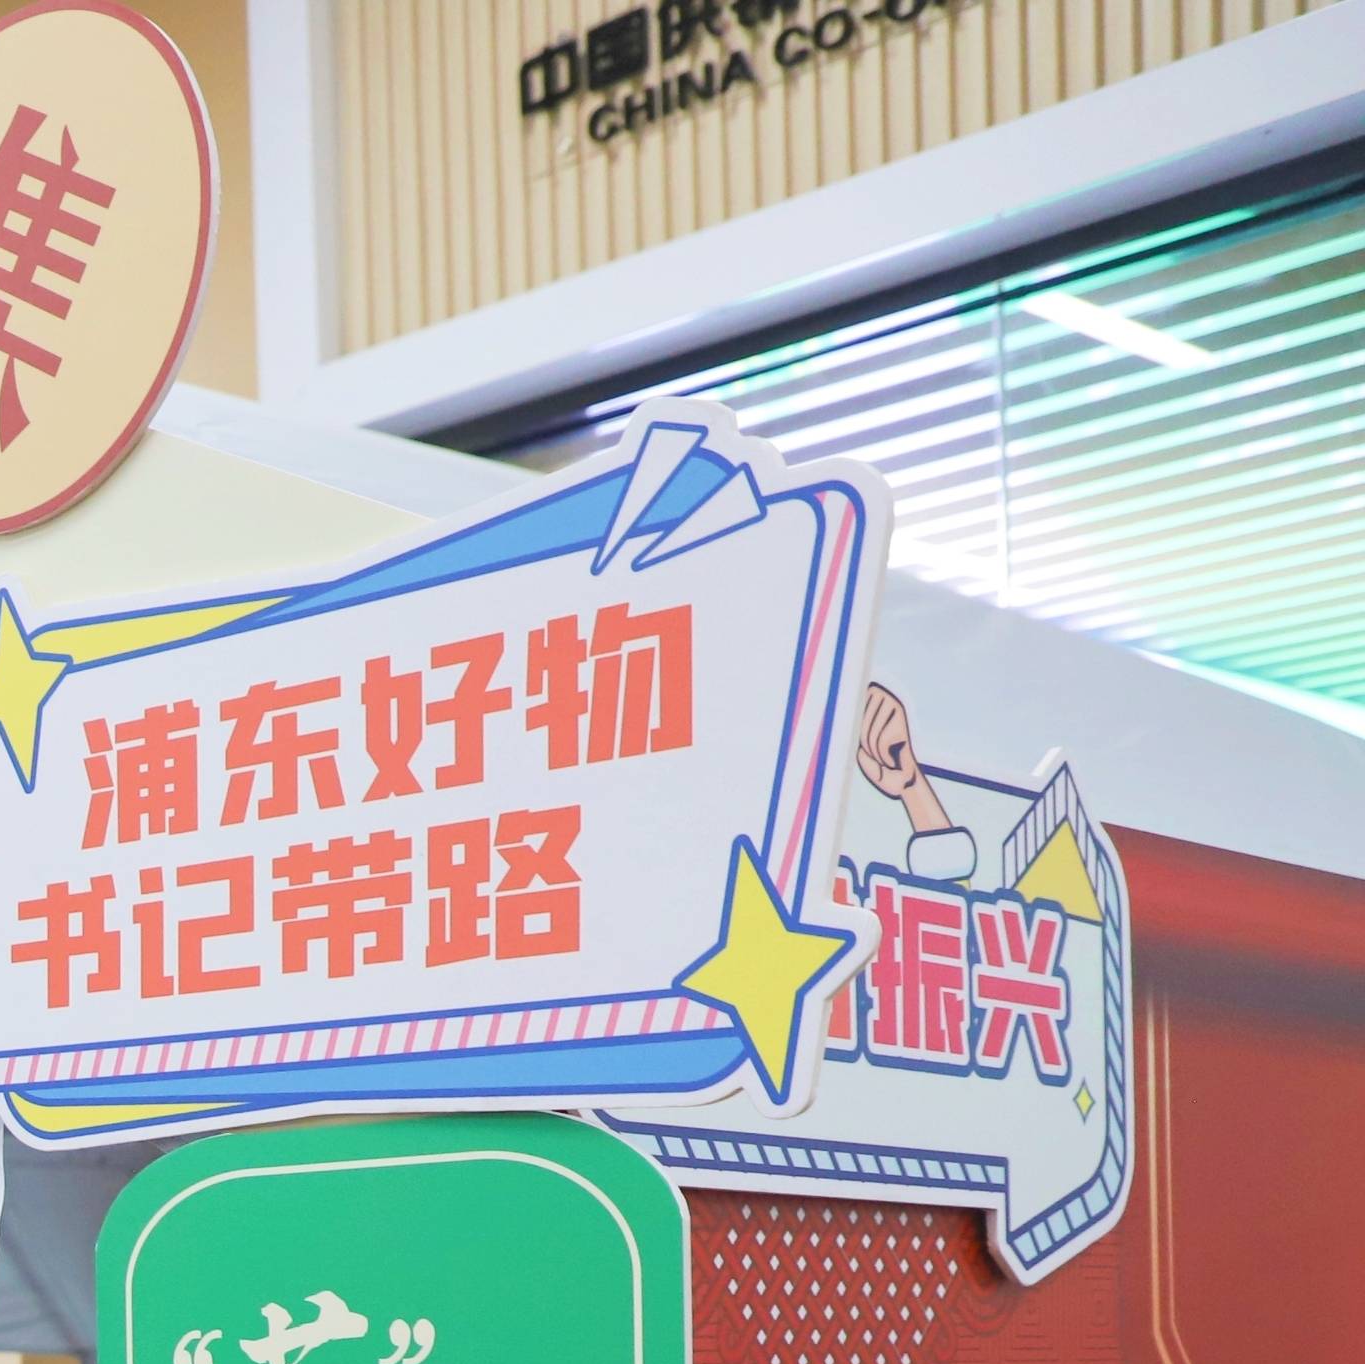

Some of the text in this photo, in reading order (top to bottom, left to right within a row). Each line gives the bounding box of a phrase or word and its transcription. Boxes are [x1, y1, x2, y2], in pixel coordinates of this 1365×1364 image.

[587, 0, 950, 143] CHINA CO-O
[80, 601, 694, 851] 浦东好物
[10, 804, 582, 1010] 书记带路
[826, 876, 1064, 1067] 振兴
